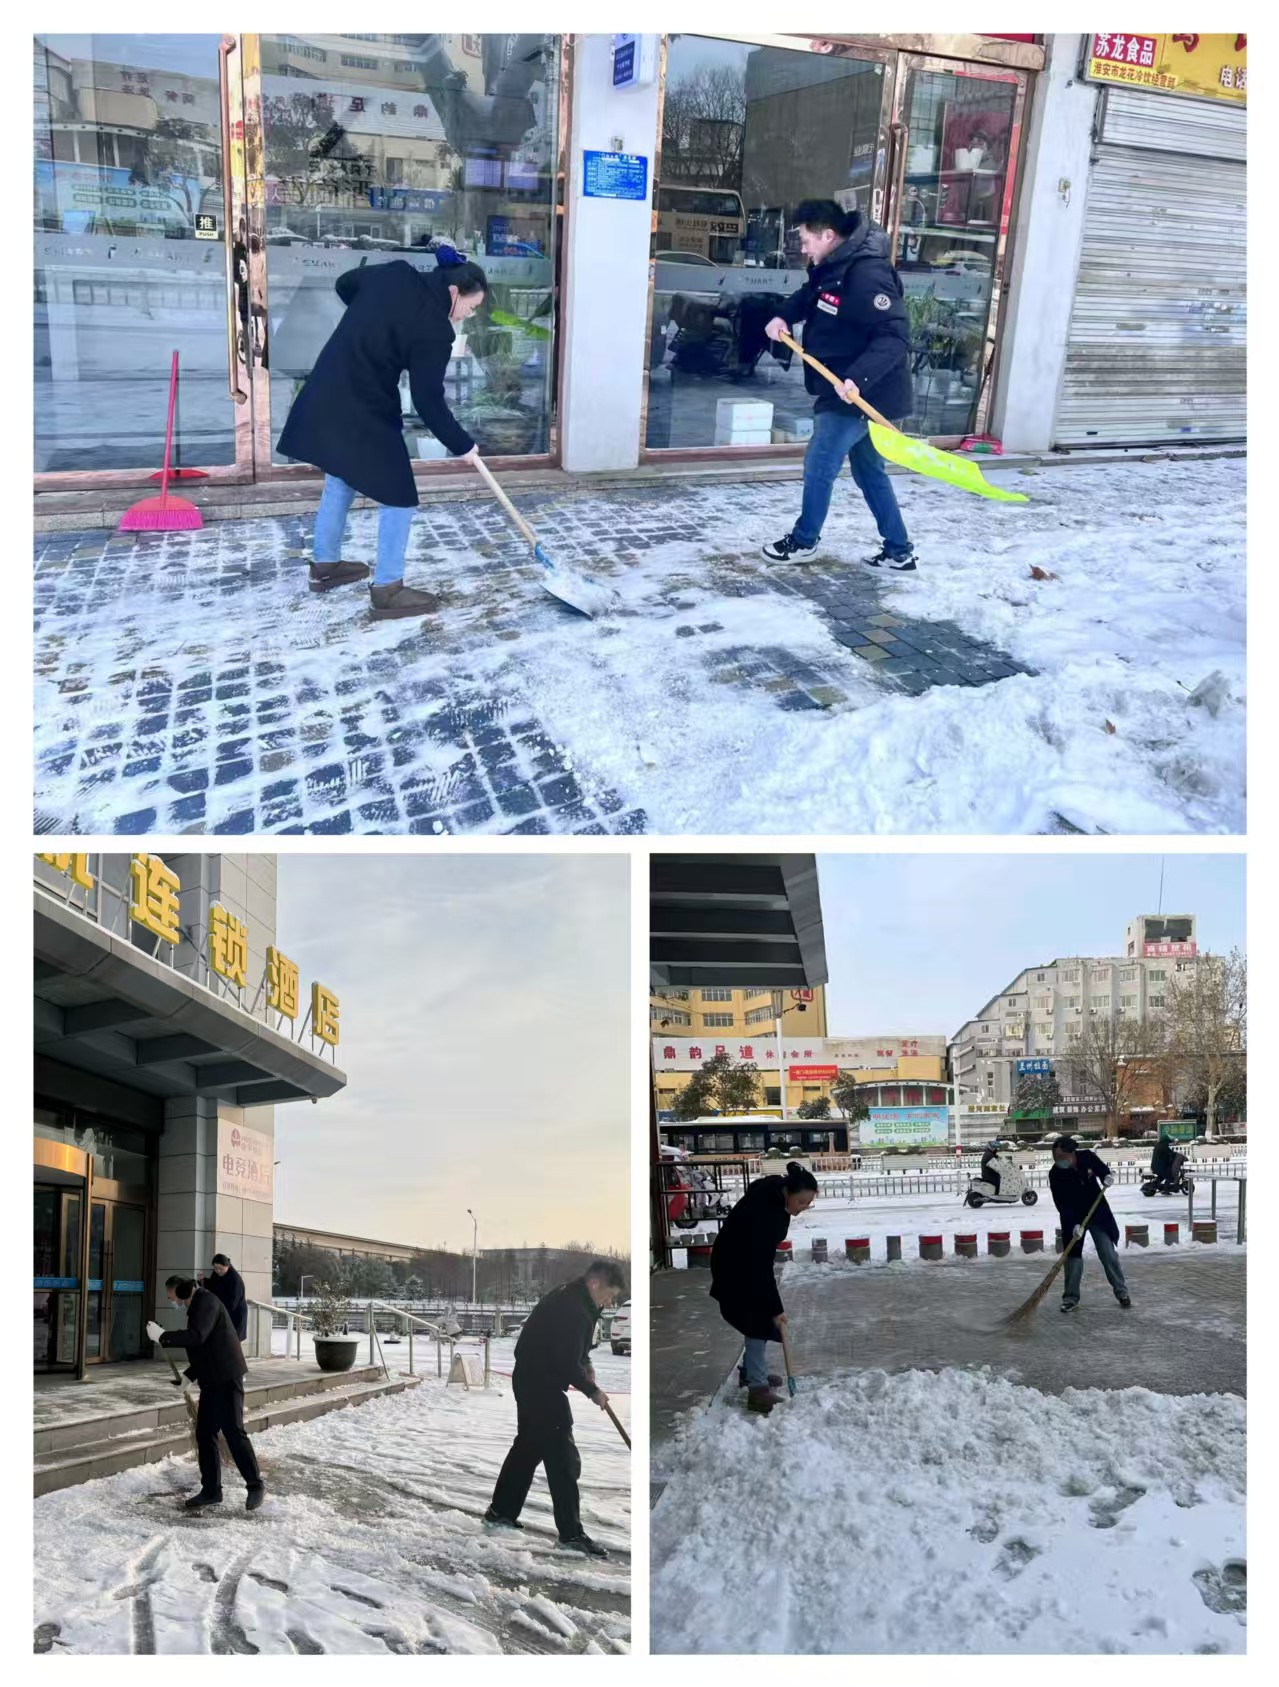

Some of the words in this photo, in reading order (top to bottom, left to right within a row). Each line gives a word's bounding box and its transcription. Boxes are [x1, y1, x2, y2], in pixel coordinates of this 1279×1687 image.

[1096, 33, 1154, 66] 苏龙食品
[199, 216, 214, 230] 推
[765, 1050, 814, 1058] 休会所
